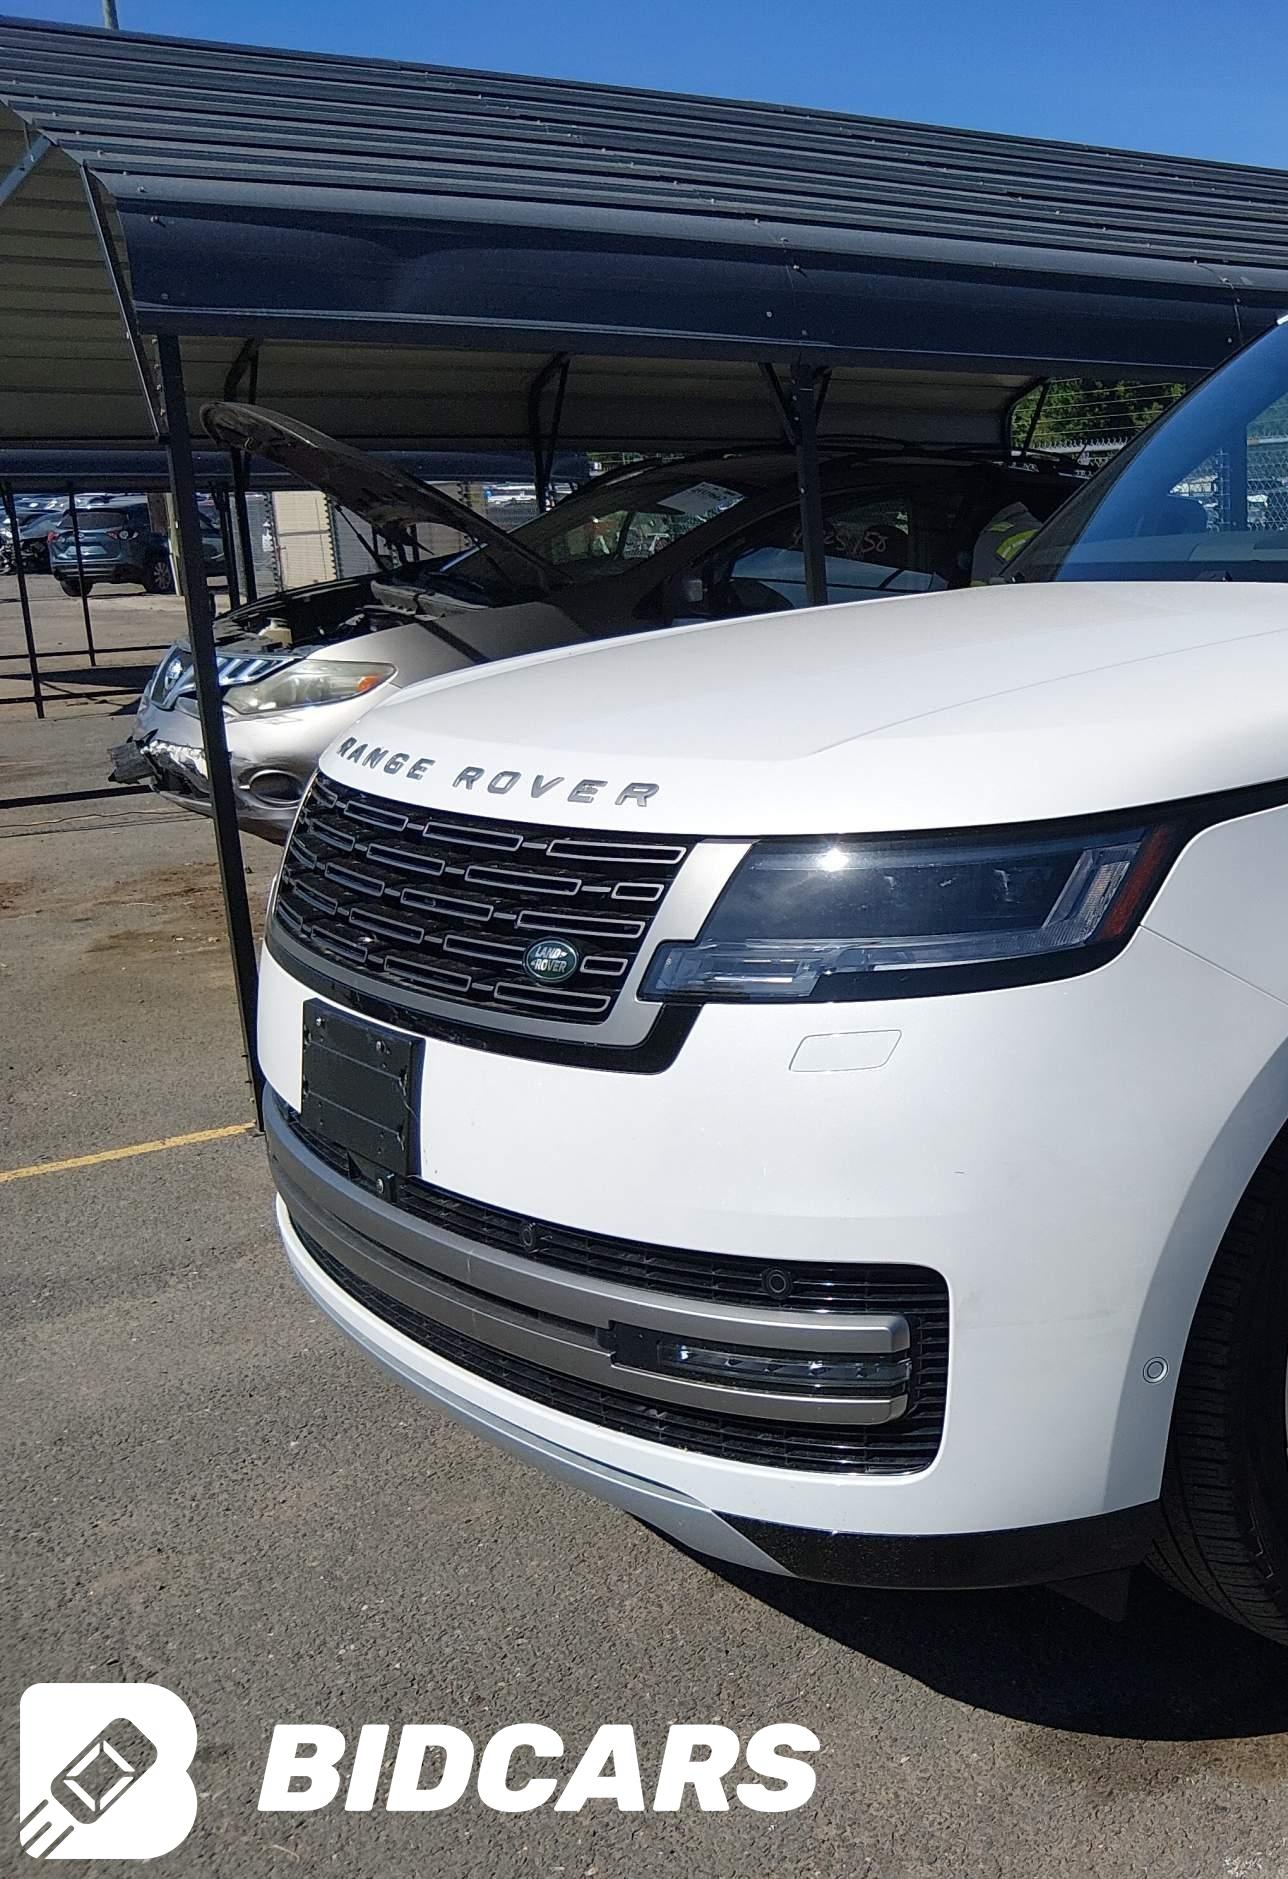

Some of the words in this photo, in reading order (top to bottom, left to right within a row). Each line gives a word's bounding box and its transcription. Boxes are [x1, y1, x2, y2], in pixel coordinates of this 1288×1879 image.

[336, 736, 435, 781] RANGE
[451, 765, 660, 808] ROVER
[534, 945, 562, 959] LAND
[533, 958, 568, 974] ROVER
